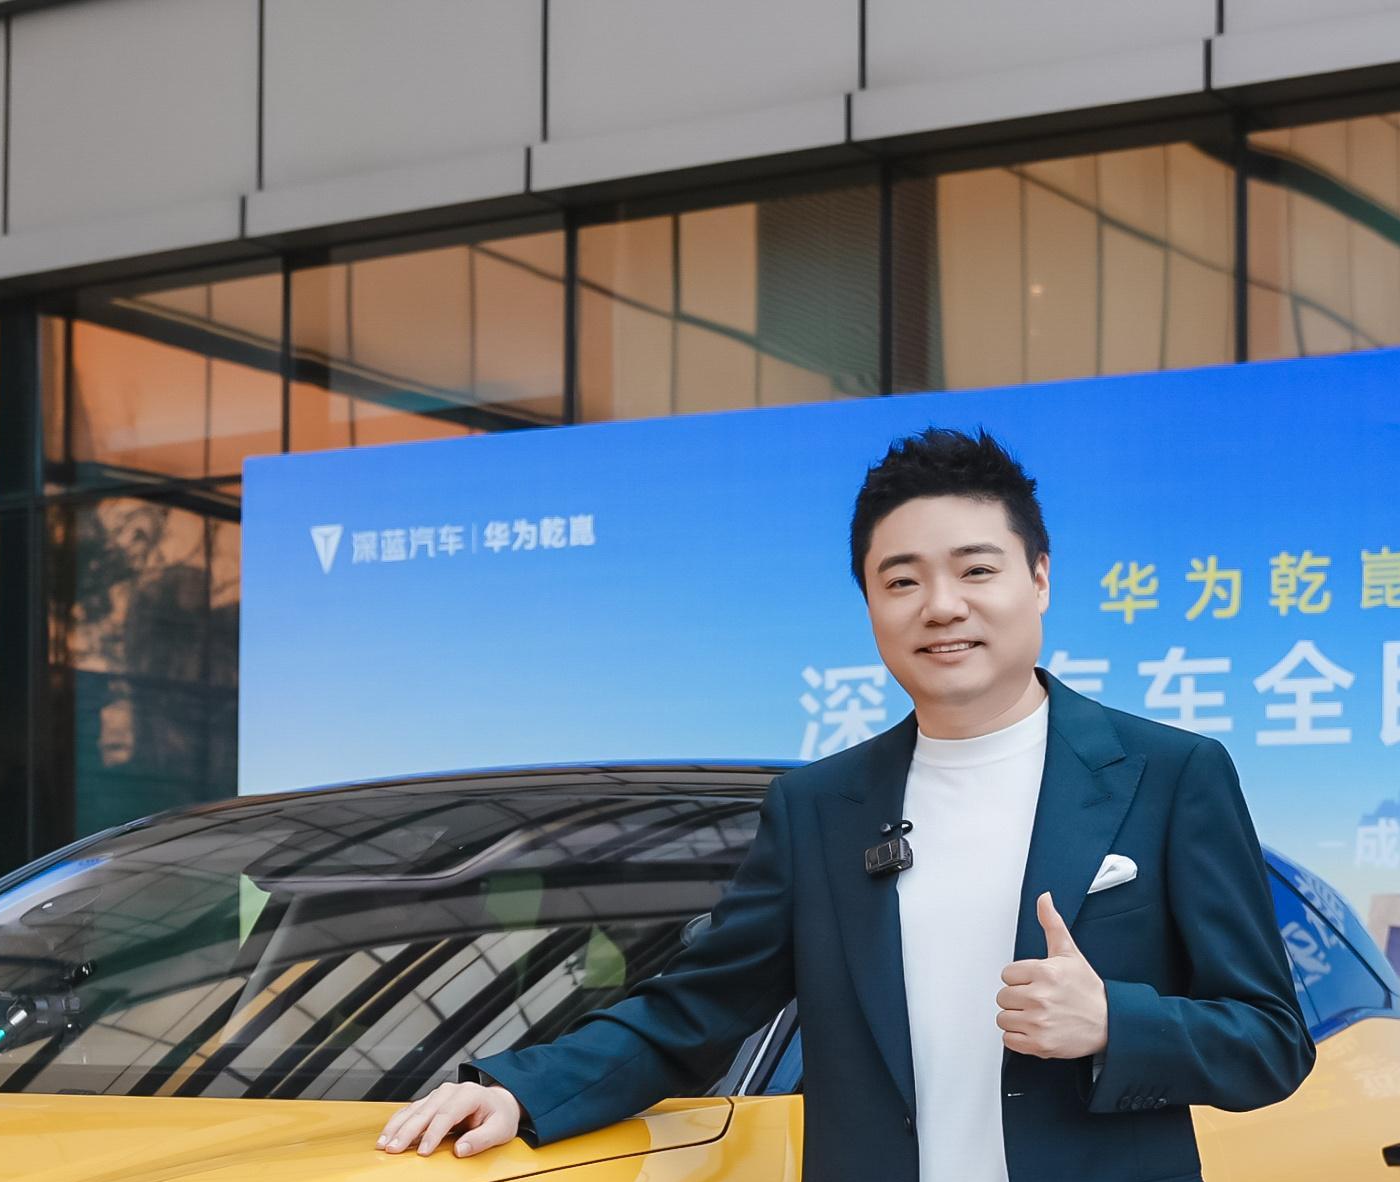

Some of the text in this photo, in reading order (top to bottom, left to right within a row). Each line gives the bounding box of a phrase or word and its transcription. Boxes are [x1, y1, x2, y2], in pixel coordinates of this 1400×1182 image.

[352, 514, 596, 564] 深蓝汽车 华为乾崑
